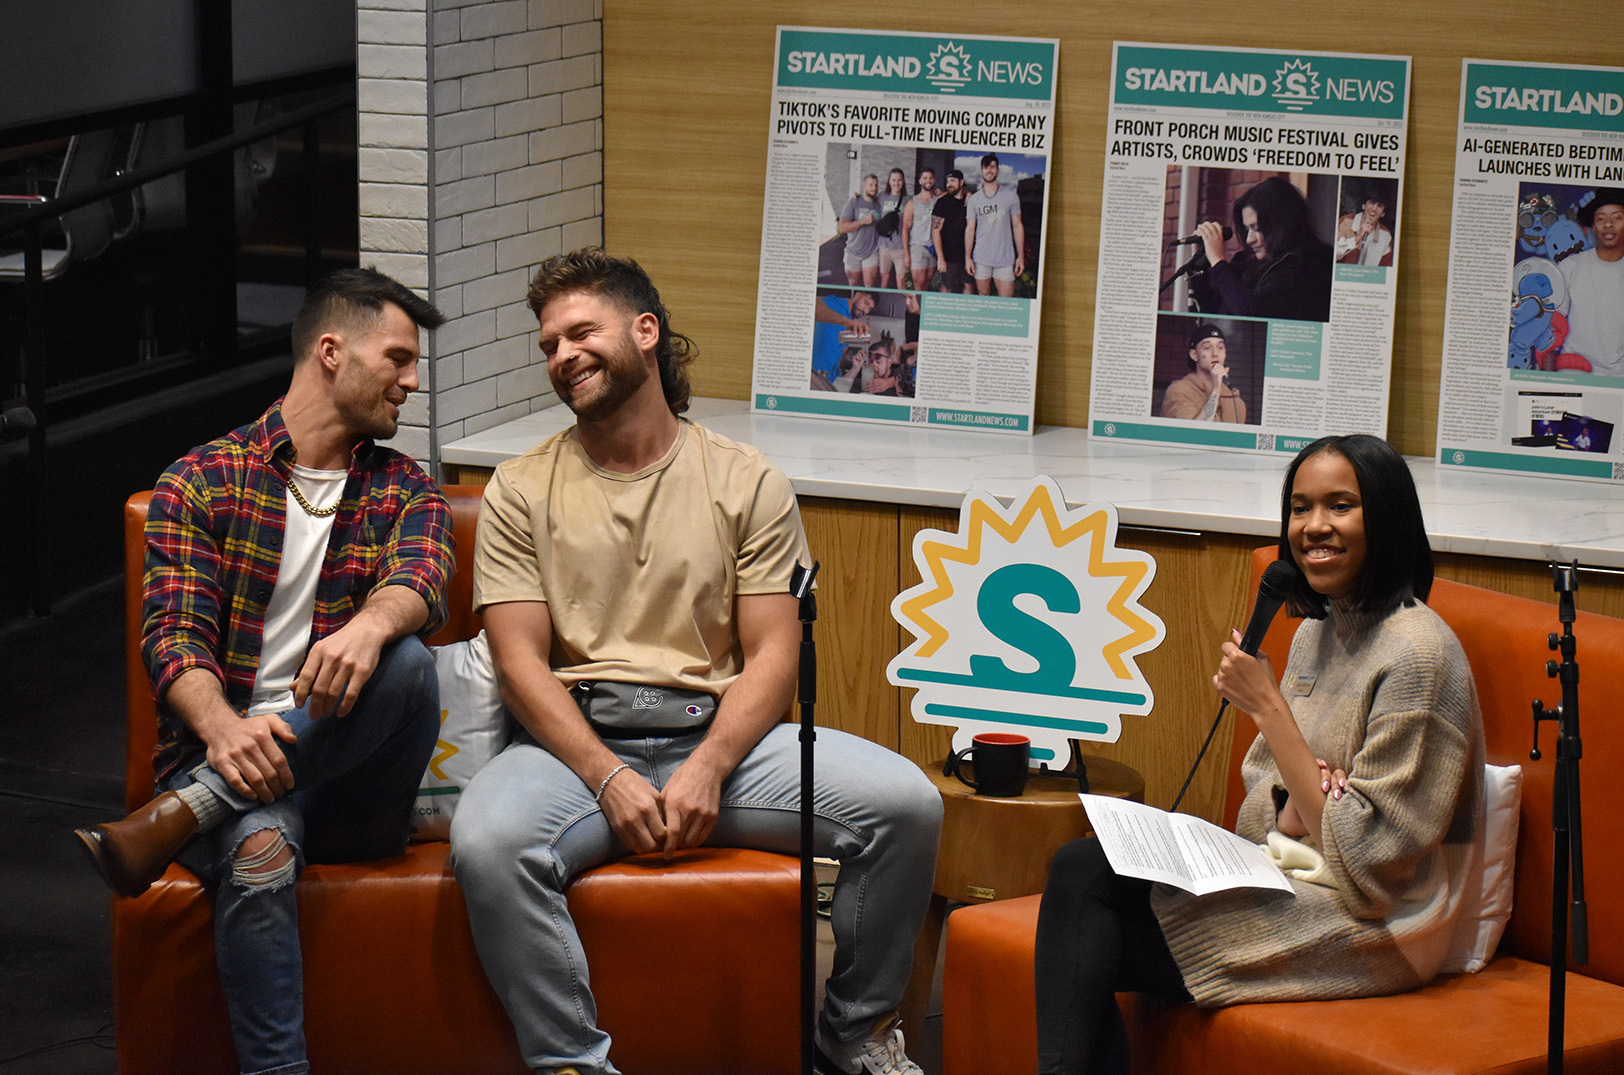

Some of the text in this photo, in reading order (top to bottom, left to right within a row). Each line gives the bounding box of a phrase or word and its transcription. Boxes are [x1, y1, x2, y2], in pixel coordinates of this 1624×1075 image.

[787, 51, 922, 79] STARTLAND
[977, 60, 1043, 85] NEWS
[1125, 67, 1268, 96] STARTLAND
[1326, 78, 1395, 103] NEWS
[1474, 85, 1624, 116] STARTLAND
[844, 105, 910, 123] FAVORITE
[914, 108, 971, 127] MOVING
[975, 111, 1047, 131] COMPANY
[777, 119, 1045, 149] PIVOTS TO FULL-TIME INFLUENCER BIZ
[1114, 119, 1399, 150] FRONT PORCH MUSIC FESTIVAL GIVES
[1111, 140, 1178, 162] ARTISTS,
[1182, 144, 1248, 163] CROWDS
[1335, 153, 1355, 170] TO
[1463, 138, 1624, 161] AI-GENERATED BEDTIM
[1478, 159, 1624, 181] LAUNCHES WITH LAN
[978, 204, 998, 216] LGM
[936, 411, 1019, 427] WWW.STARTLANDNEWS.COM
